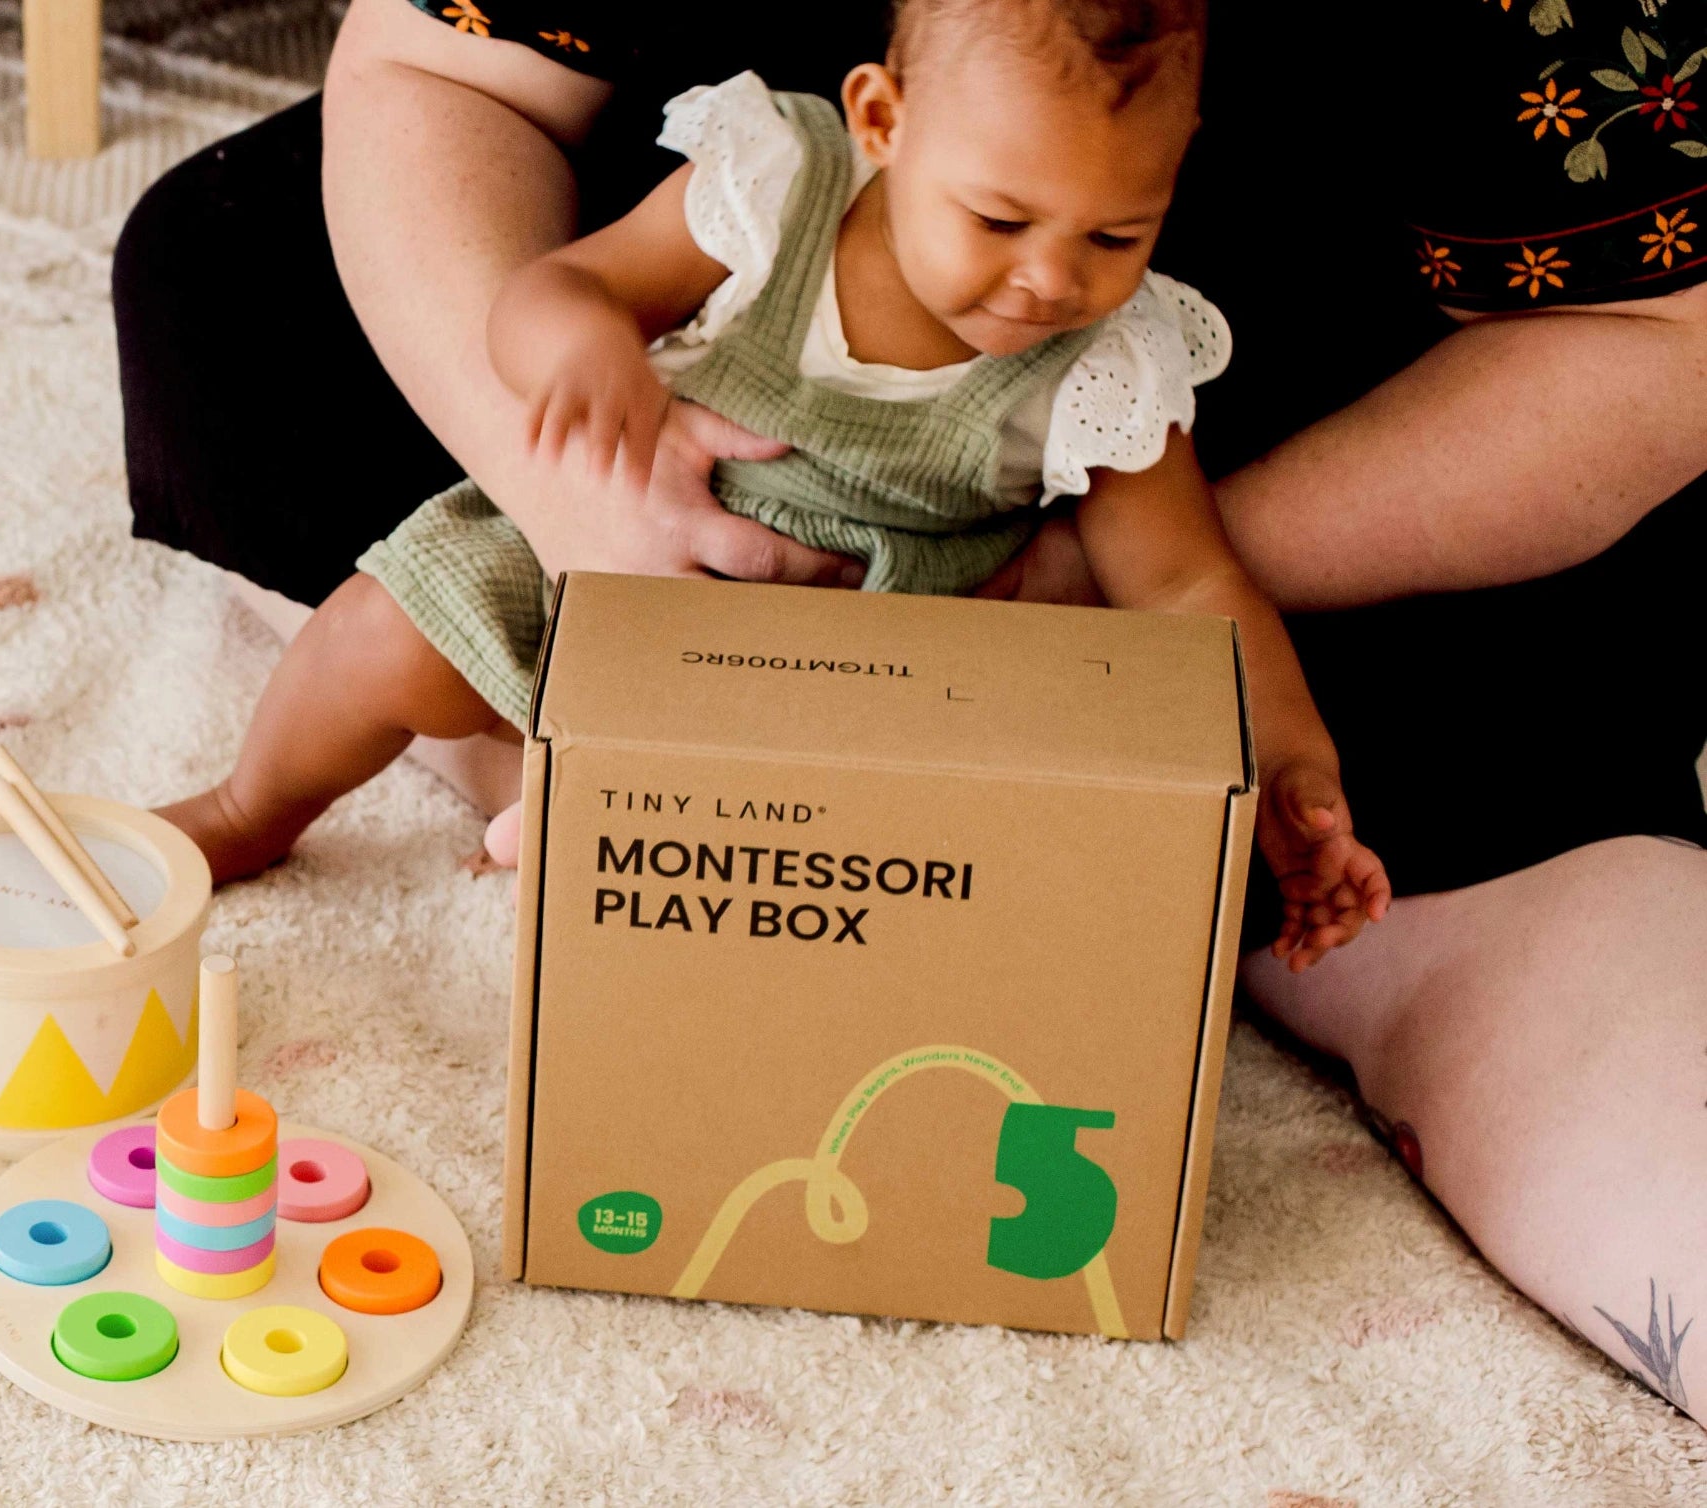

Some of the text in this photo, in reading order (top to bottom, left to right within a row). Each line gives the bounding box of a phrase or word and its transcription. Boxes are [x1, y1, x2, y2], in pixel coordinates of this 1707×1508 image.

[681, 651, 913, 677] TLTGMT006RC
[600, 789, 691, 814] TINY
[596, 836, 973, 900] MONTESSORI
[594, 888, 870, 945] PLAY BOX
[987, 1101, 1117, 1280] 5
[595, 1207, 648, 1227] 13-15
[593, 1224, 647, 1238] MONTHS
